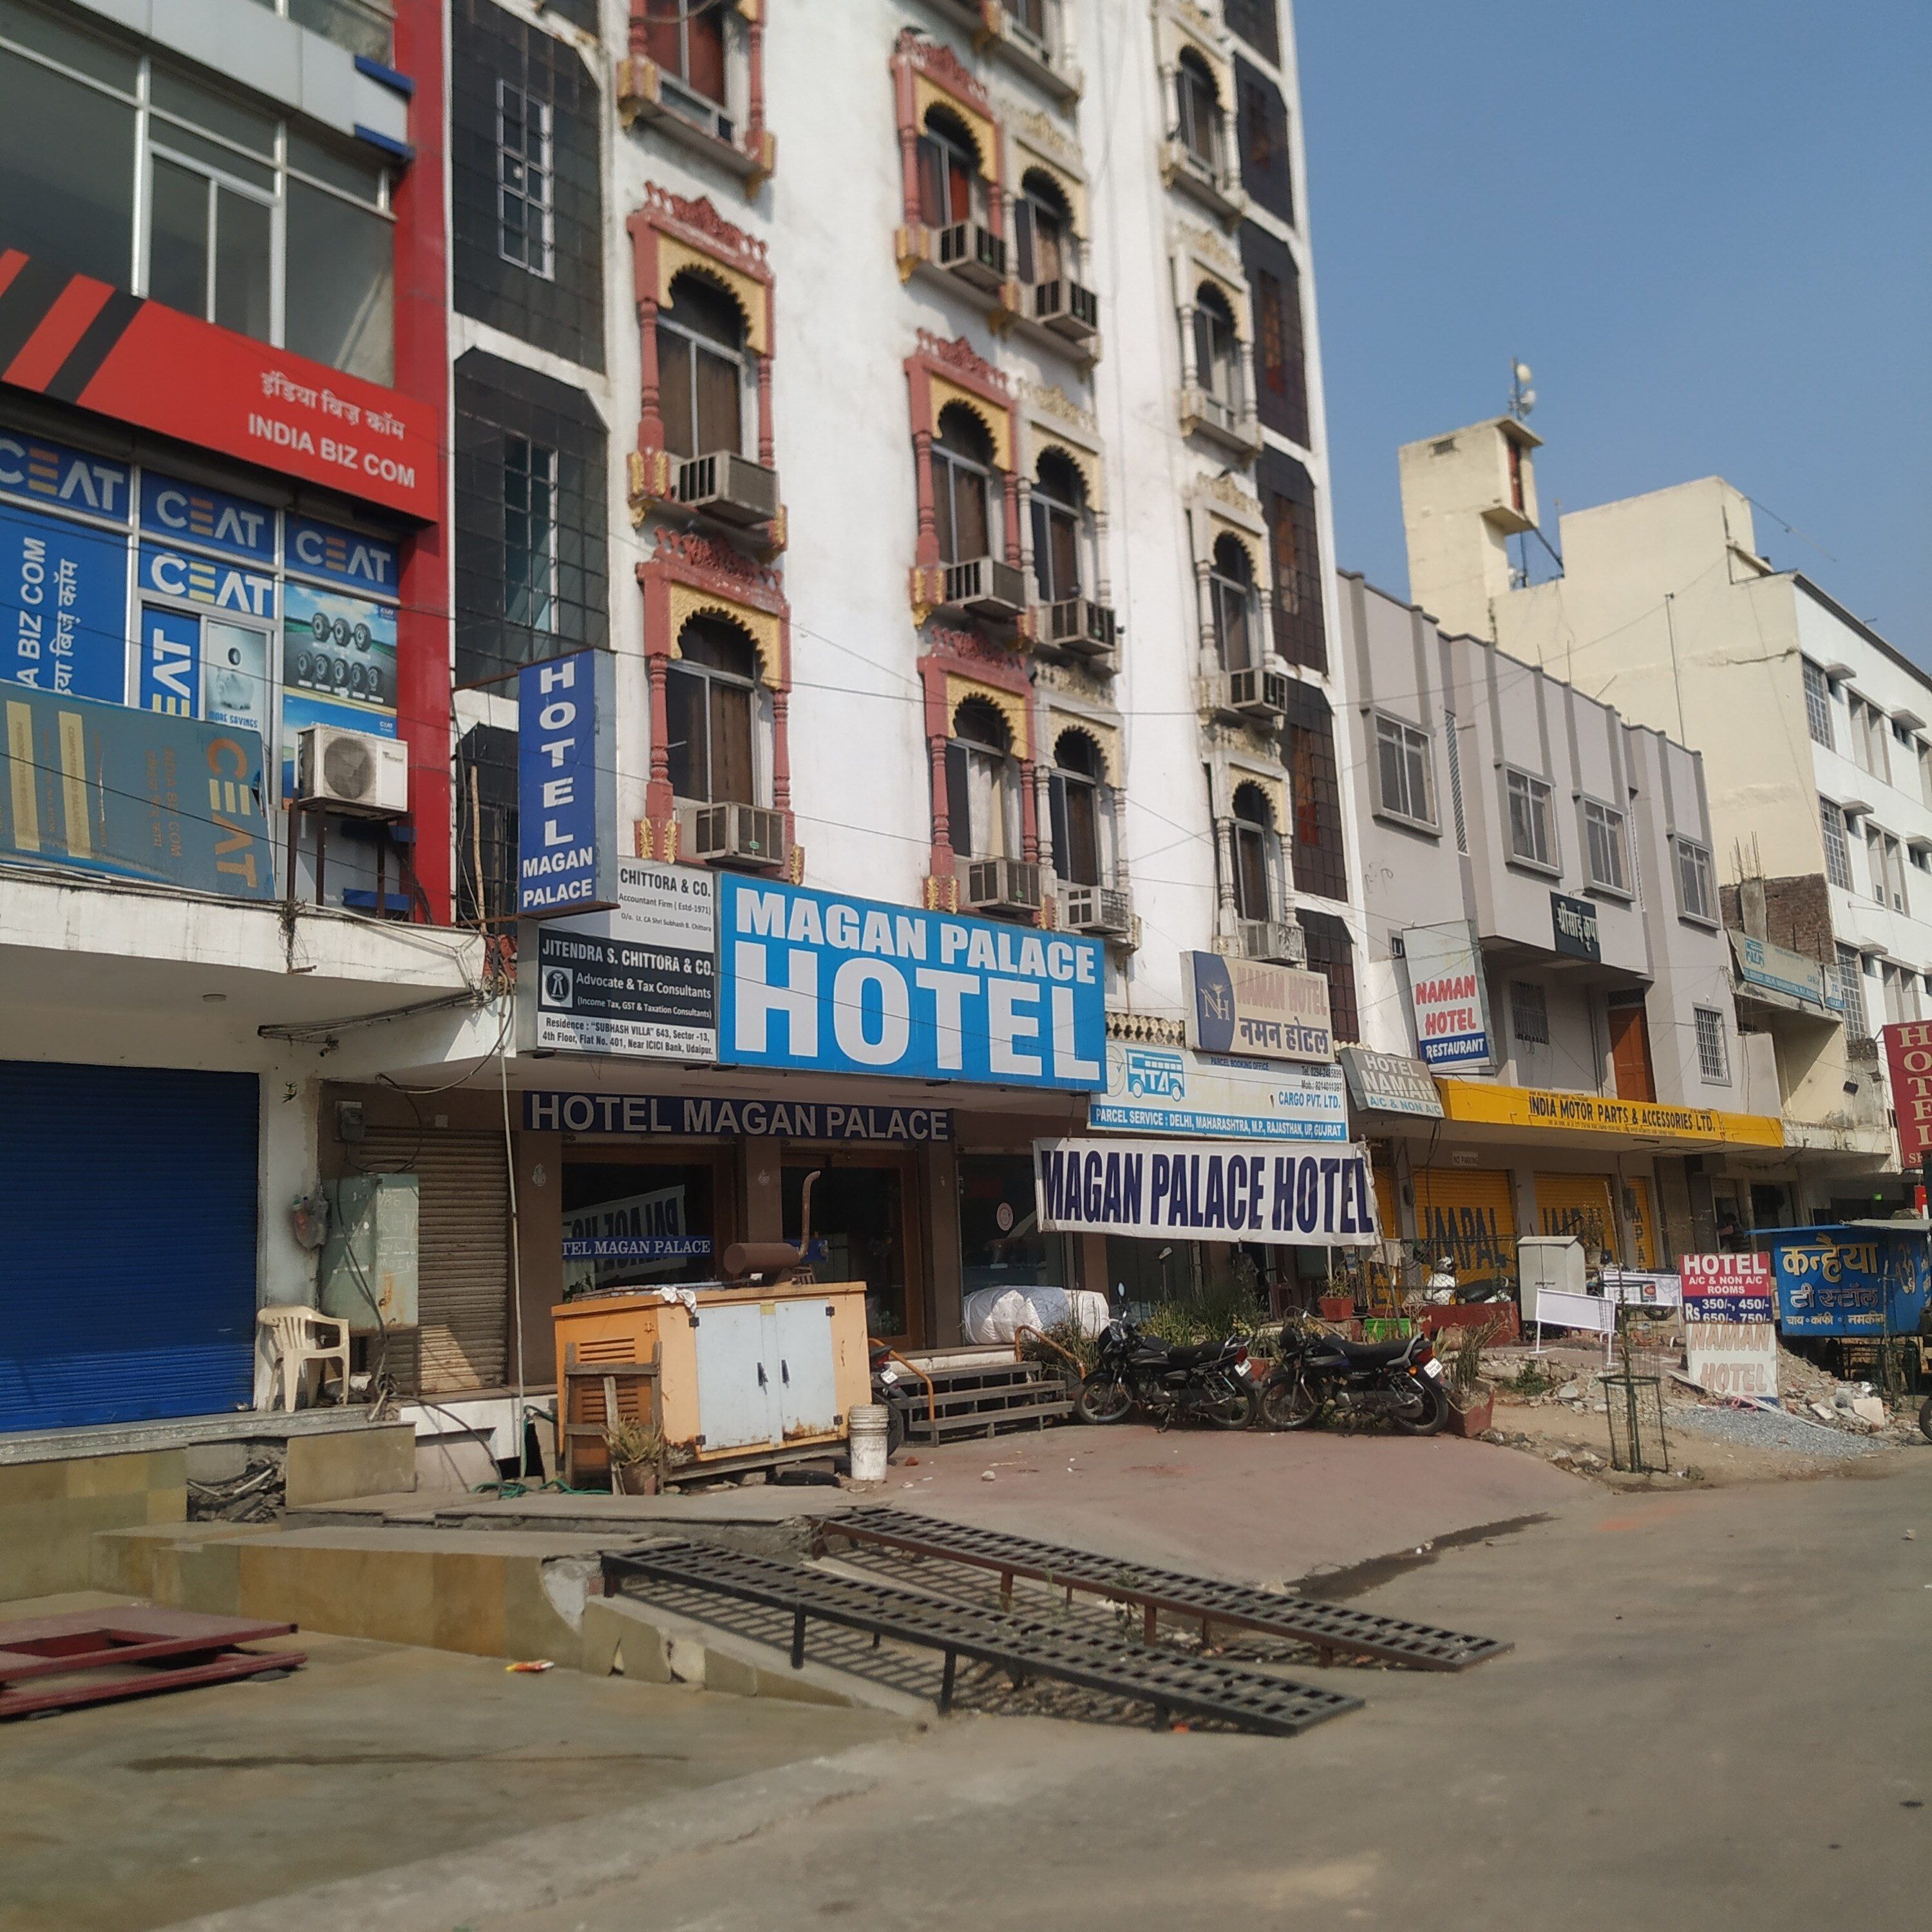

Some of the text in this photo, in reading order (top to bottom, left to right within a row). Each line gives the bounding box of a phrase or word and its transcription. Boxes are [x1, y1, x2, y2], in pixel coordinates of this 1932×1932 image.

[249, 412, 415, 488] INDIA BIZ COM
[0, 439, 124, 511] CEAT
[156, 491, 265, 547] CEAT
[21, 537, 46, 605] COM
[296, 531, 392, 583] CEAT
[151, 553, 275, 615] CEAT
[17, 610, 43, 659] BIZ
[540, 661, 576, 847] HOTEL
[207, 738, 257, 889] CEAT
[169, 820, 183, 858] COM
[523, 848, 593, 878] MAGAN
[523, 878, 592, 908] PALACE
[620, 868, 711, 897] CHITTORA & CO.
[619, 893, 656, 907] Accountant
[658, 900, 673, 908] Firm
[652, 916, 663, 925] Shri
[663, 919, 685, 928] Subhash
[692, 923, 712, 932] Chittora
[736, 887, 1095, 985] MAGAN PALACE
[542, 939, 714, 976] JITENDRA S. CHITTORA & CO.
[576, 972, 712, 999] Advocate & Tax Consultants
[1236, 966, 1328, 1016] NAMAN HOTEL
[1416, 974, 1475, 1005] NAMAN
[577, 996, 606, 1007] (Income
[607, 999, 621, 1010] Tax,
[622, 1001, 636, 1010] GST
[636, 1002, 643, 1011] &
[644, 1003, 672, 1014] Taxation
[673, 1007, 712, 1019] Consultants)
[735, 940, 1101, 1081] HOTEL
[1425, 1007, 1477, 1036] HOTEL
[542, 1031, 713, 1056] 4th Floor, Flat No. 401, Near ICICI Bank, Udaipur.
[546, 1017, 584, 1030] Residence
[673, 1030, 694, 1040] Sector
[1238, 1016, 1329, 1054] नमन होटल
[1426, 1038, 1484, 1059] RESTAURANT
[1364, 1054, 1419, 1078] HOTEL
[1278, 1091, 1341, 1109] CARGO PVT. LTD.
[1361, 1070, 1437, 1102] NAMAN
[1897, 1025, 1932, 1146] HOTEL
[532, 1094, 949, 1141] HOTEL MAGAN PALACE
[1370, 1096, 1442, 1115] A/C & NON A/C
[1529, 1095, 1557, 1117] INDIA
[1559, 1099, 1593, 1121] MOTOR
[1597, 1104, 1629, 1124] PARTS
[1632, 1108, 1638, 1125] &
[1642, 1109, 1692, 1130] ACCESSORIES
[1696, 1114, 1716, 1132] LTD.
[1095, 1108, 1128, 1124] PARCEL
[1129, 1110, 1164, 1126] SERVICE
[1170, 1113, 1194, 1131] DELHI,
[1196, 1115, 1251, 1135] MAHARASHTRA,
[1267, 1121, 1303, 1137] RAJASTHAN,
[1314, 1124, 1341, 1137] GUJRAT
[1041, 1150, 1374, 1235] MAGAN PALACE HOTEL
[594, 1240, 650, 1255] MAGAN
[654, 1239, 711, 1254] PALACE
[1780, 1233, 1879, 1283] कन्हैया
[1683, 1254, 1767, 1275] HOTEL
[1689, 1276, 1763, 1285] A/C & NON A/C
[1707, 1285, 1745, 1295] ROOMS
[1790, 1282, 1879, 1309] टी स्टॉल
[1685, 1302, 1700, 1321] Rs
[1701, 1298, 1770, 1311] 350/-, 450/-
[1739, 1313, 1770, 1323] 750/-
[1785, 1316, 1804, 1325] चाय
[1810, 1311, 1833, 1325] कॉफी
[1690, 1323, 1770, 1351] NAMAN
[1700, 1362, 1768, 1392] HOTEL
